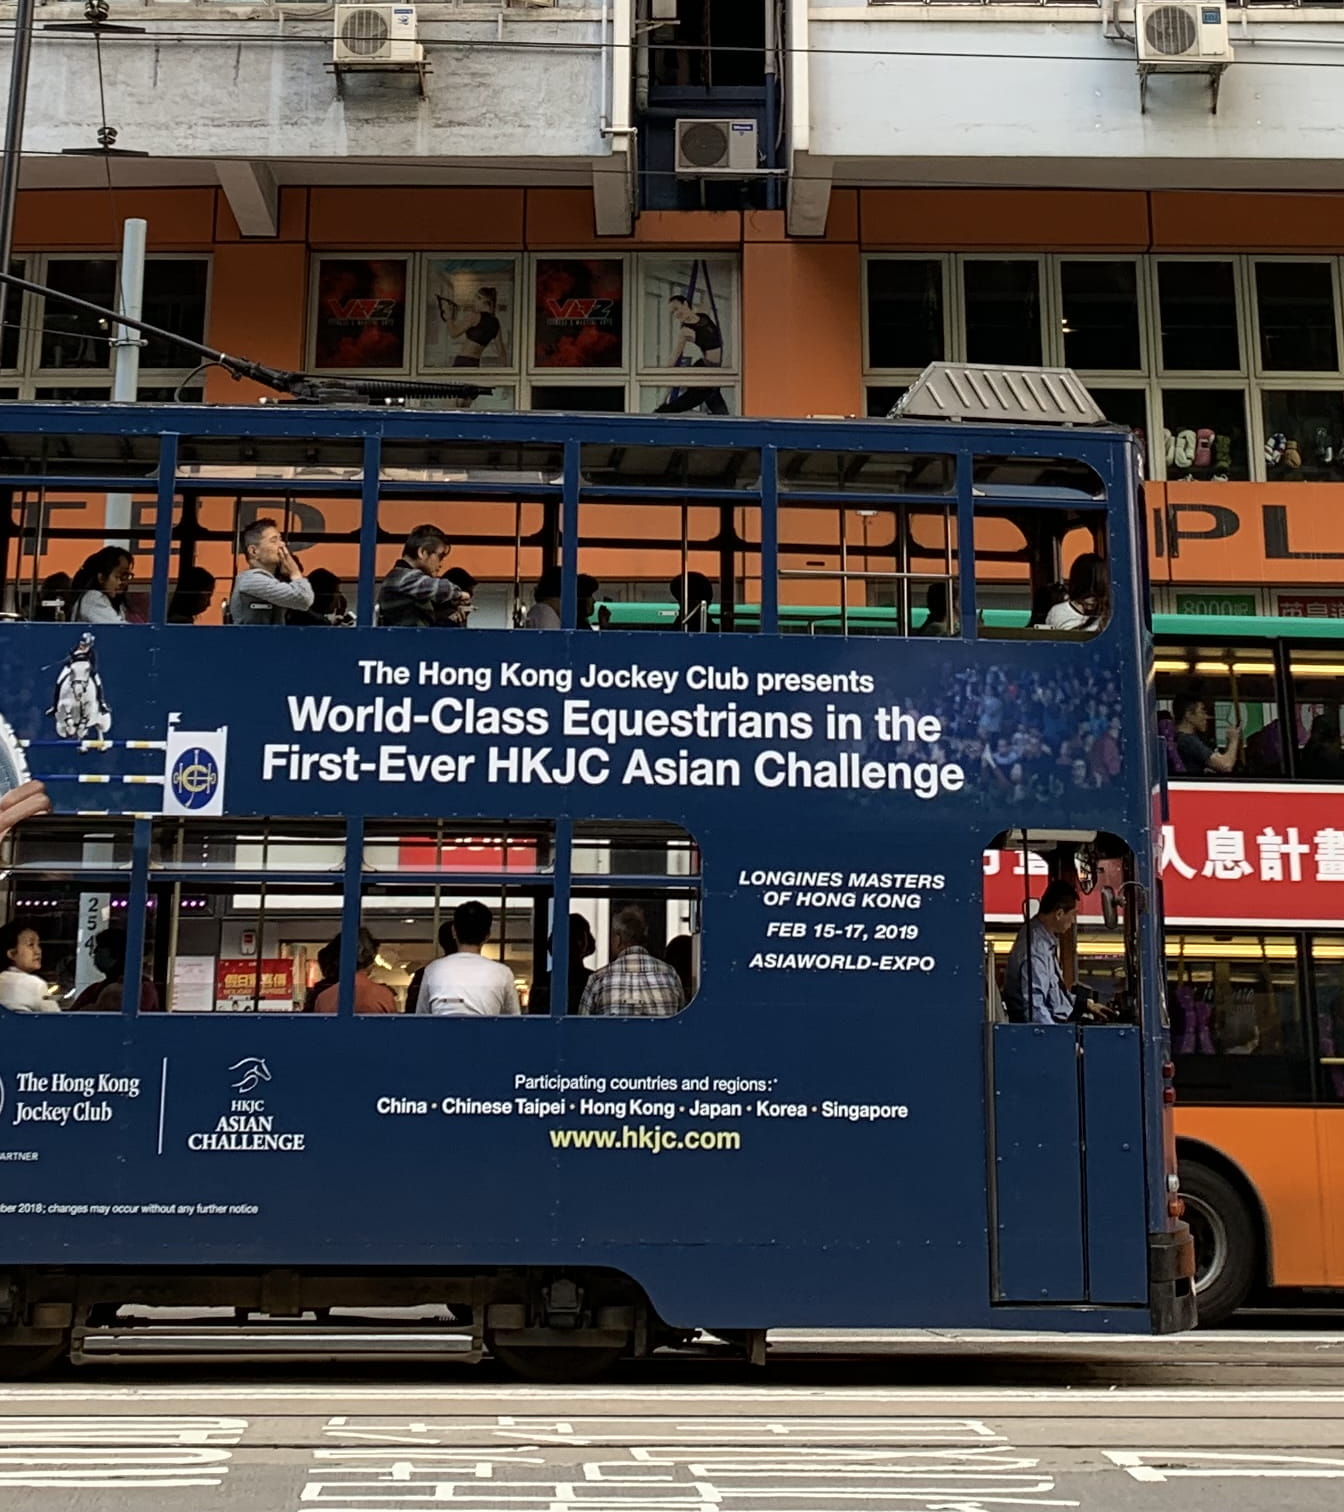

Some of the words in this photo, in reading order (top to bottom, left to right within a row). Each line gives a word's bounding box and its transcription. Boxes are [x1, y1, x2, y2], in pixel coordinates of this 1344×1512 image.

[358, 660, 411, 685] The
[419, 662, 492, 691] Hong
[501, 663, 573, 692] Kong
[580, 665, 679, 694] Jockey
[686, 666, 749, 691] Club
[757, 670, 874, 696] presents
[287, 696, 550, 735] World-Class
[563, 700, 813, 744] Equestrians
[827, 704, 862, 740] in
[874, 706, 942, 742] the
[262, 744, 475, 782] First-Ever
[488, 747, 610, 785] HKJC
[622, 749, 740, 786] Asian
[755, 750, 965, 799] Challenge
[739, 870, 843, 887] LONGINES
[848, 873, 945, 889] MASTERS
[763, 891, 792, 906] OF
[796, 892, 857, 908] HONG
[861, 893, 921, 909] KONG
[766, 922, 806, 937] FEB
[813, 923, 868, 941] 15-17,
[874, 924, 918, 939] 2019
[749, 953, 935, 971] ASIAWORLD-EXPO
[16, 1071, 48, 1092] The
[52, 1073, 95, 1097] Hong
[98, 1074, 140, 1097] Kong
[515, 1074, 606, 1093] Participating
[610, 1075, 677, 1090] countries
[681, 1076, 708, 1091] and
[13, 1100, 70, 1126] Jockey
[73, 1101, 113, 1122] Club
[231, 1100, 264, 1113] HKJC
[376, 1097, 428, 1114] China
[441, 1098, 512, 1115] Chinese
[515, 1098, 565, 1118] Taipei
[580, 1099, 626, 1119] Hong
[630, 1099, 675, 1119] Kong
[689, 1100, 742, 1119] Japan
[756, 1100, 807, 1117] Korea
[821, 1101, 908, 1121] Singapore
[215, 1115, 274, 1133] ASIAN
[188, 1134, 305, 1151] CHALLENGE
[549, 1125, 741, 1153] www.hkjc.com
[47, 1203, 88, 1216] changes
[90, 1205, 110, 1216] may
[112, 1204, 139, 1214] occur
[141, 1203, 176, 1214] without
[177, 1204, 195, 1216] any
[196, 1203, 227, 1215] further
[229, 1203, 259, 1215] notice
